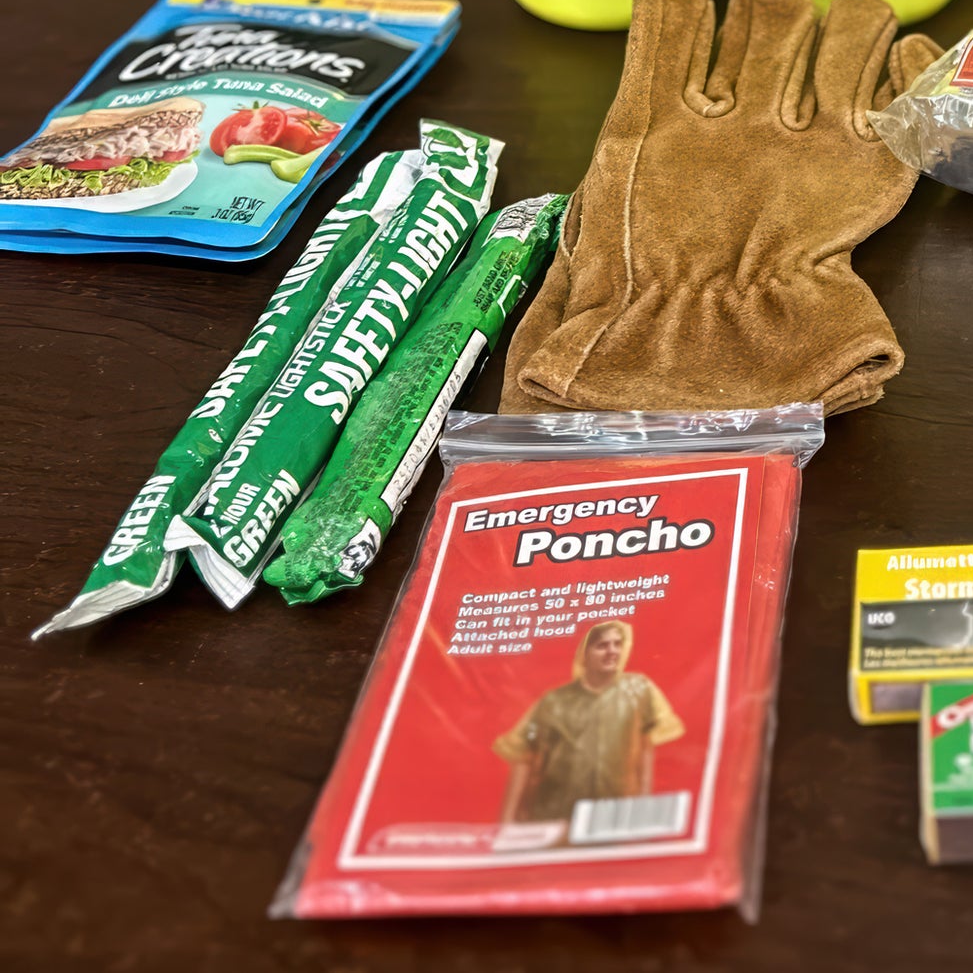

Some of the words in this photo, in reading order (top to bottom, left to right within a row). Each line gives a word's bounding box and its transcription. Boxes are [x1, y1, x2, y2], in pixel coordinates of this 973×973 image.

[174, 23, 281, 51] Tuna
[118, 43, 366, 82] Creations
[107, 90, 154, 108] Deli
[213, 77, 266, 92] Tuna
[266, 82, 329, 108] Salad
[303, 189, 469, 426] SAFETY-LIGHT
[103, 474, 176, 566] GREEN
[223, 469, 301, 568] GREEN
[463, 494, 660, 533] Emergency
[514, 518, 714, 567] Poncho
[458, 602, 539, 617] Measures
[544, 597, 565, 610] 50
[570, 599, 580, 607] x
[610, 588, 665, 603] inches
[462, 588, 537, 605] Compact
[540, 583, 571, 598] and
[576, 574, 670, 595] lightweight
[454, 619, 488, 630] Can
[492, 616, 511, 627] fit
[515, 614, 531, 626] in
[536, 611, 574, 626] your
[576, 604, 636, 623] pocket
[867, 611, 896, 625] UCO
[447, 643, 493, 655] Adult
[498, 642, 532, 653] size
[450, 627, 529, 643] Attached
[533, 623, 576, 637] hood
